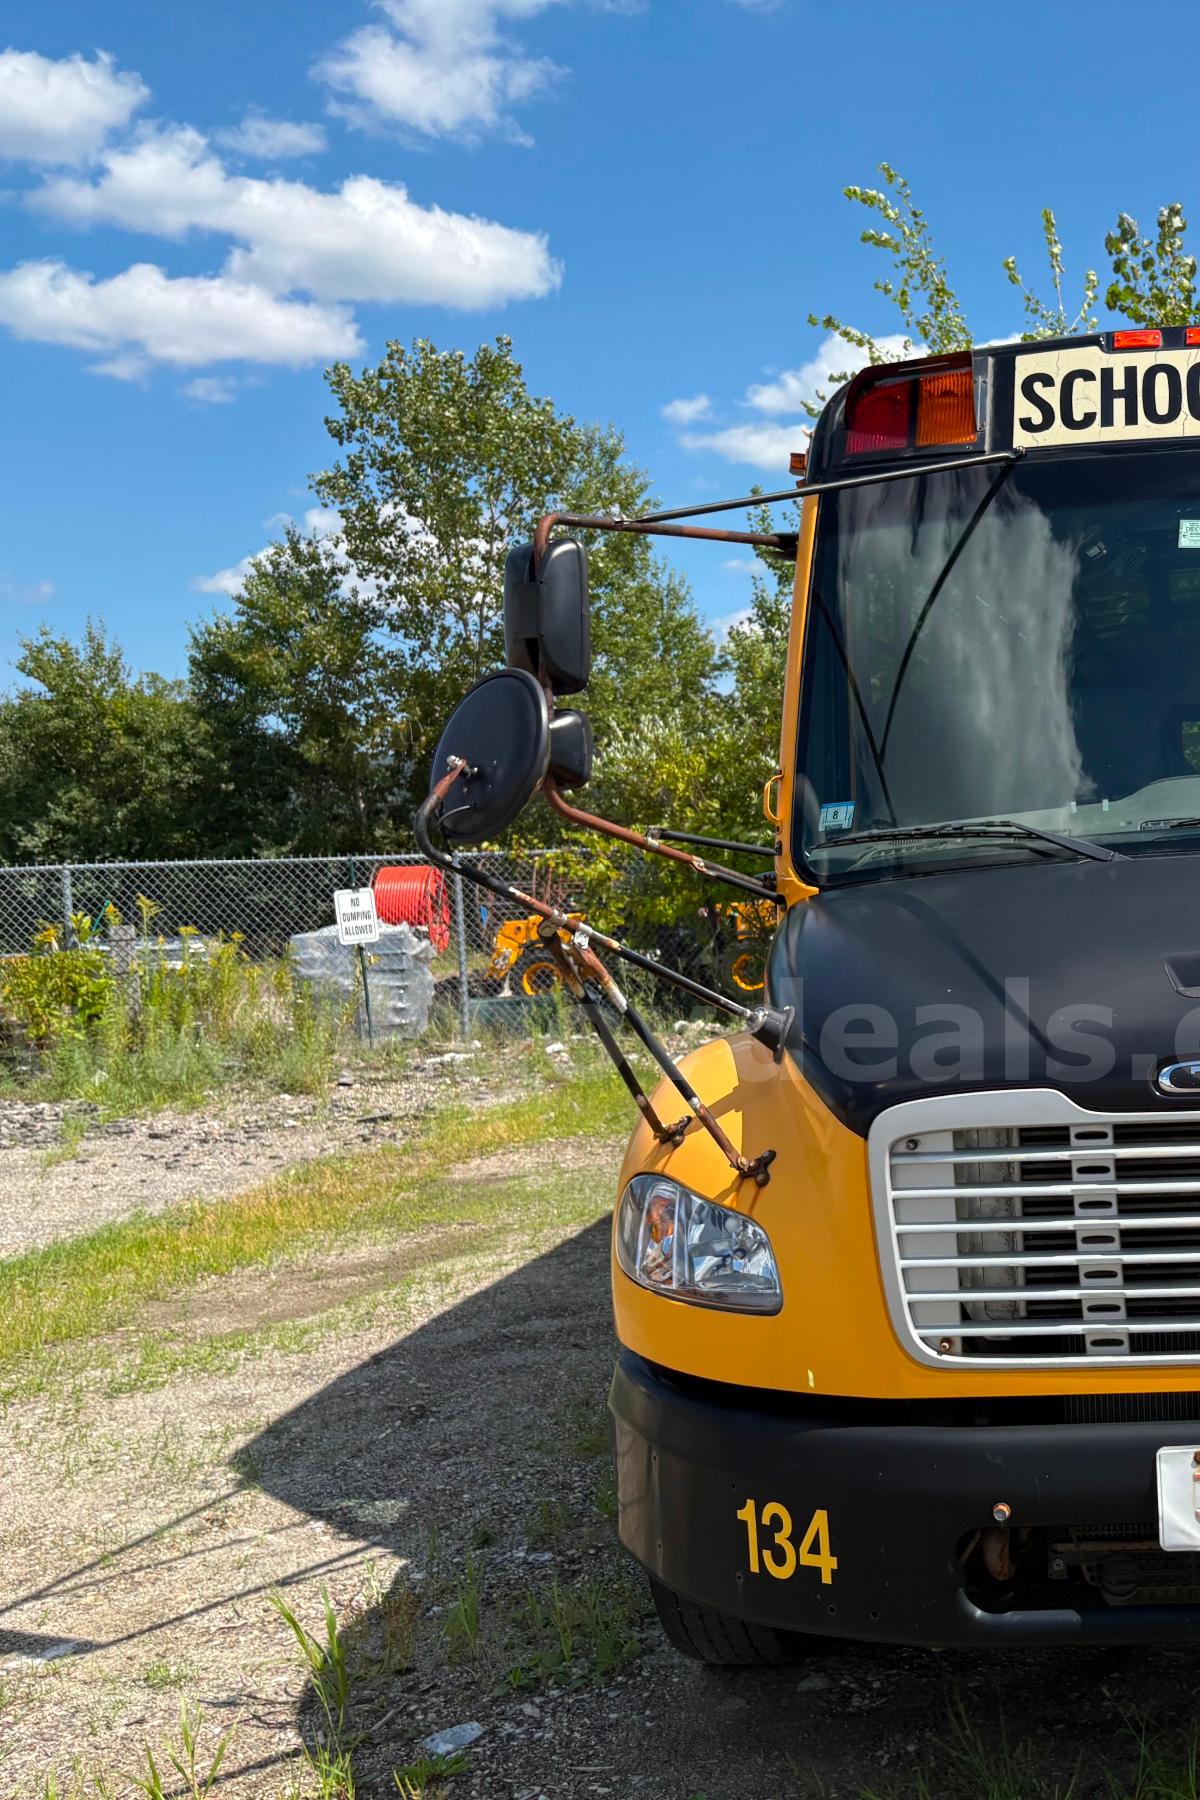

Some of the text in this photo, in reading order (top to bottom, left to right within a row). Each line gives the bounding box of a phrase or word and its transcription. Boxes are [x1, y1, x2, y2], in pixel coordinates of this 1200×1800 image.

[832, 810, 839, 820] 8
[350, 897, 360, 907] NO
[342, 910, 372, 922] DUMPING
[344, 924, 373, 936] ALLOWED
[736, 1498, 838, 1585] 134
